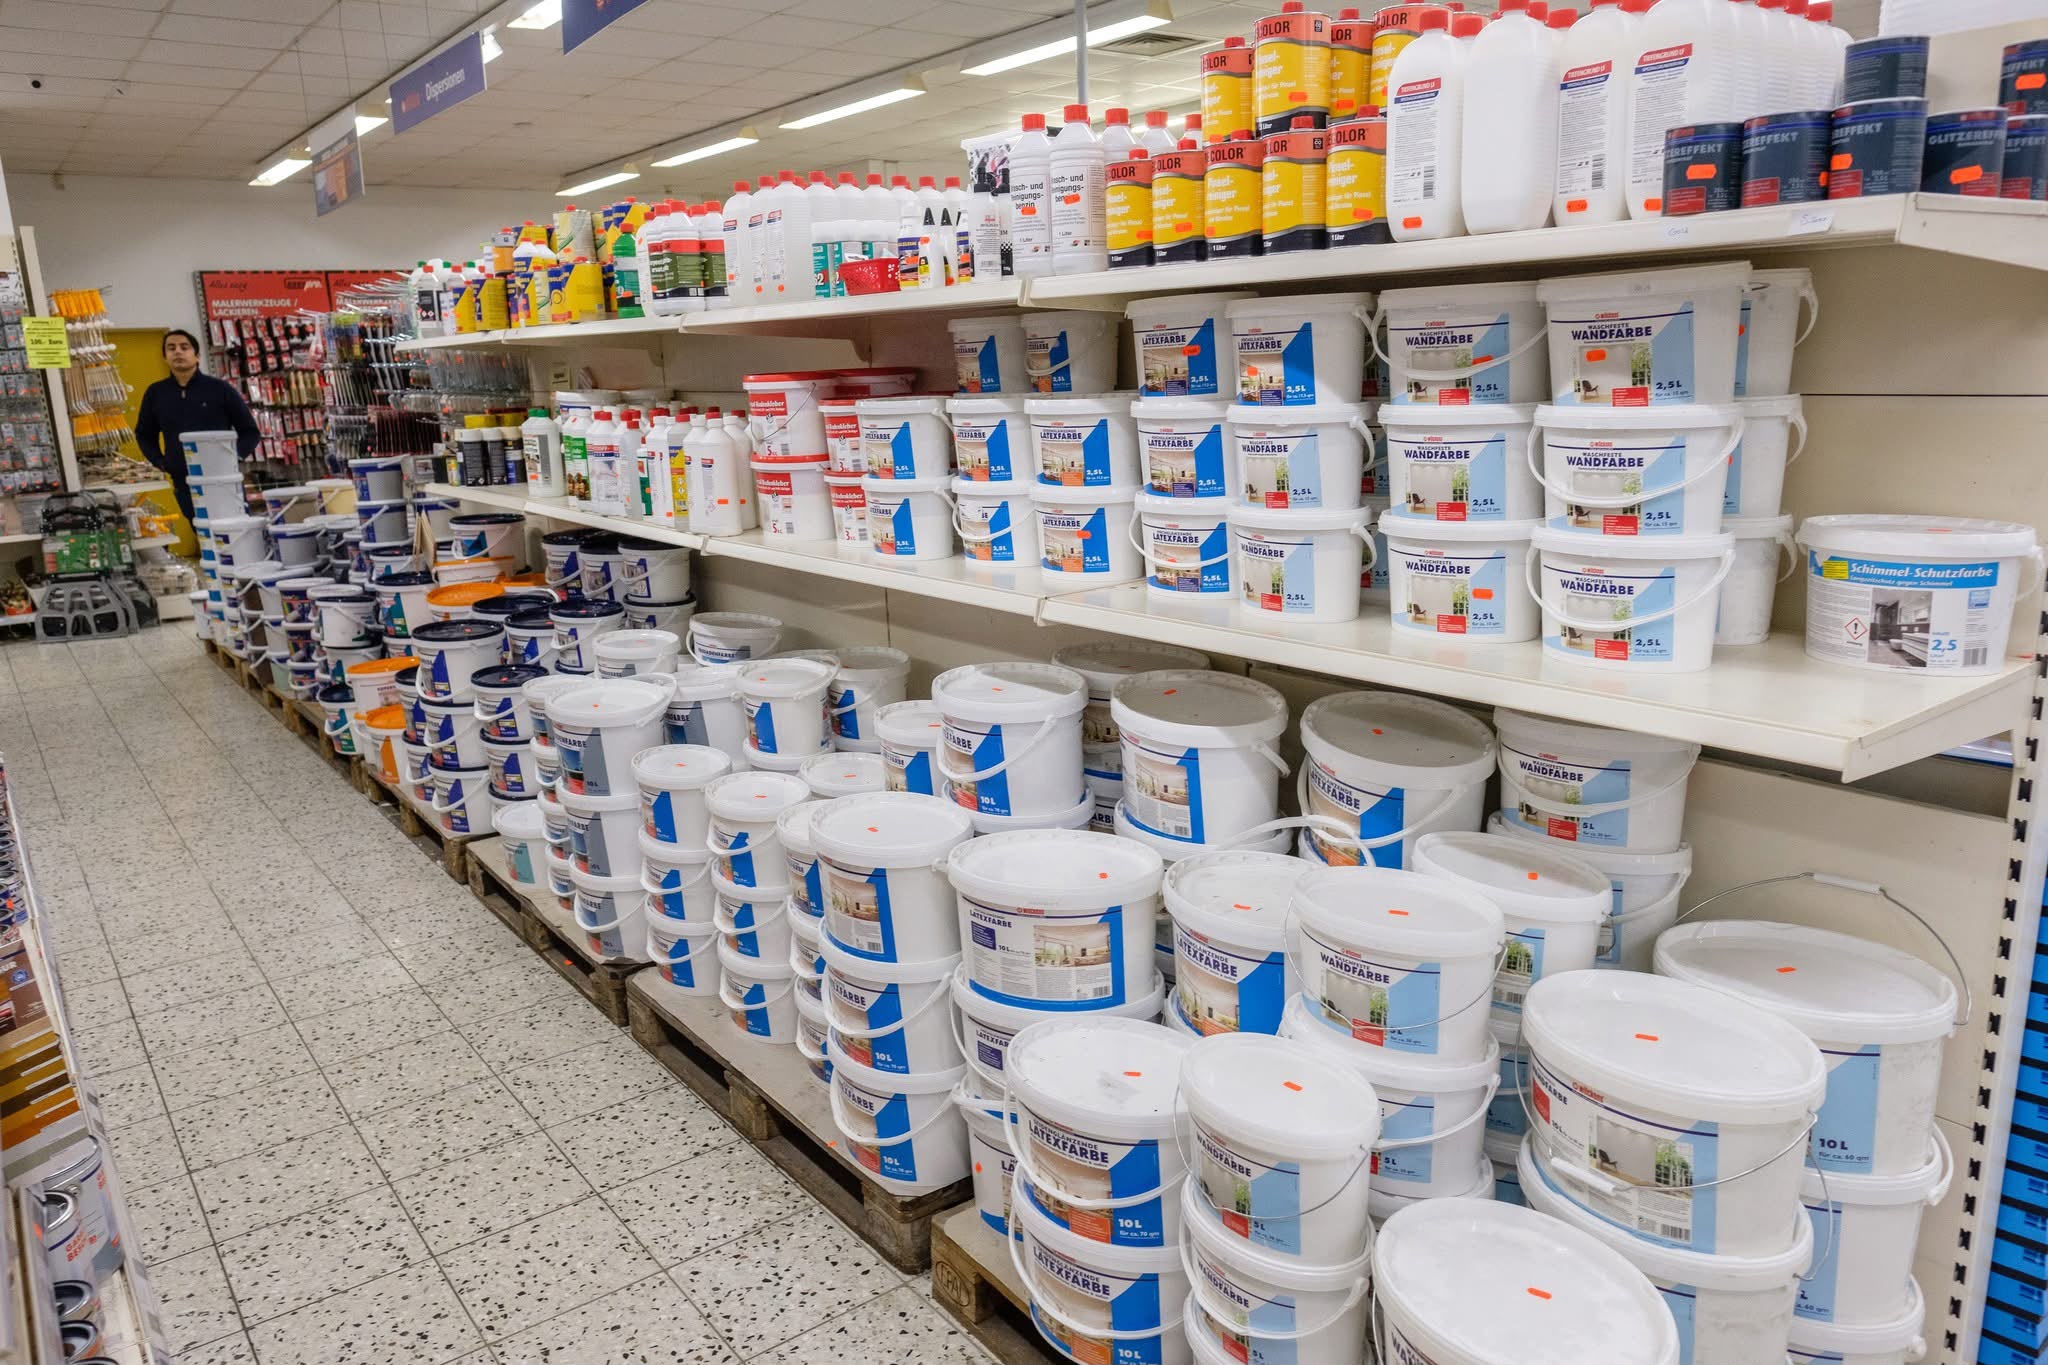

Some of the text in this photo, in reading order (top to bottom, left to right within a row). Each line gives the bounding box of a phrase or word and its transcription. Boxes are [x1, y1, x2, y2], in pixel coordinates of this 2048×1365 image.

[425, 68, 466, 103] Dispersionen
[1069, 173, 1084, 182] und
[1030, 182, 1044, 190] und
[211, 298, 291, 308] MALERWERKZEUGE
[1571, 326, 1652, 341] WANDFARBE
[1142, 335, 1187, 345] LATEXFARBE
[1238, 340, 1283, 350] LATEXFARBE
[1405, 334, 1473, 346] WANDFARBE
[1040, 431, 1082, 440] LATEXFARBE
[1147, 439, 1194, 449] LATEXFARBE
[1242, 444, 1288, 453] WANDFARBE
[1404, 449, 1470, 460] WANDFARBE
[1567, 456, 1644, 467] WANDFARBE
[1042, 518, 1081, 528] LATEXFARBE
[1152, 533, 1199, 544] LATEXFARBE
[1405, 561, 1471, 574] WANDFARBE
[1850, 562, 1993, 579] Schimmel-Schutzfarbe
[1560, 578, 1635, 596] WANDFARBE
[1931, 638, 1958, 653] 2,5
[1519, 760, 1584, 783] WANDFARBE
[969, 909, 1013, 928] LATEXFARBE
[1175, 938, 1238, 978] LATEXFARBE
[1320, 952, 1390, 984] WANDFARBE
[1028, 1119, 1109, 1164] LATEXFARBE
[1196, 1134, 1252, 1178] WANDFARBE
[1818, 1151, 1829, 1159] für
[1033, 1246, 1110, 1296] LATEXFARBE
